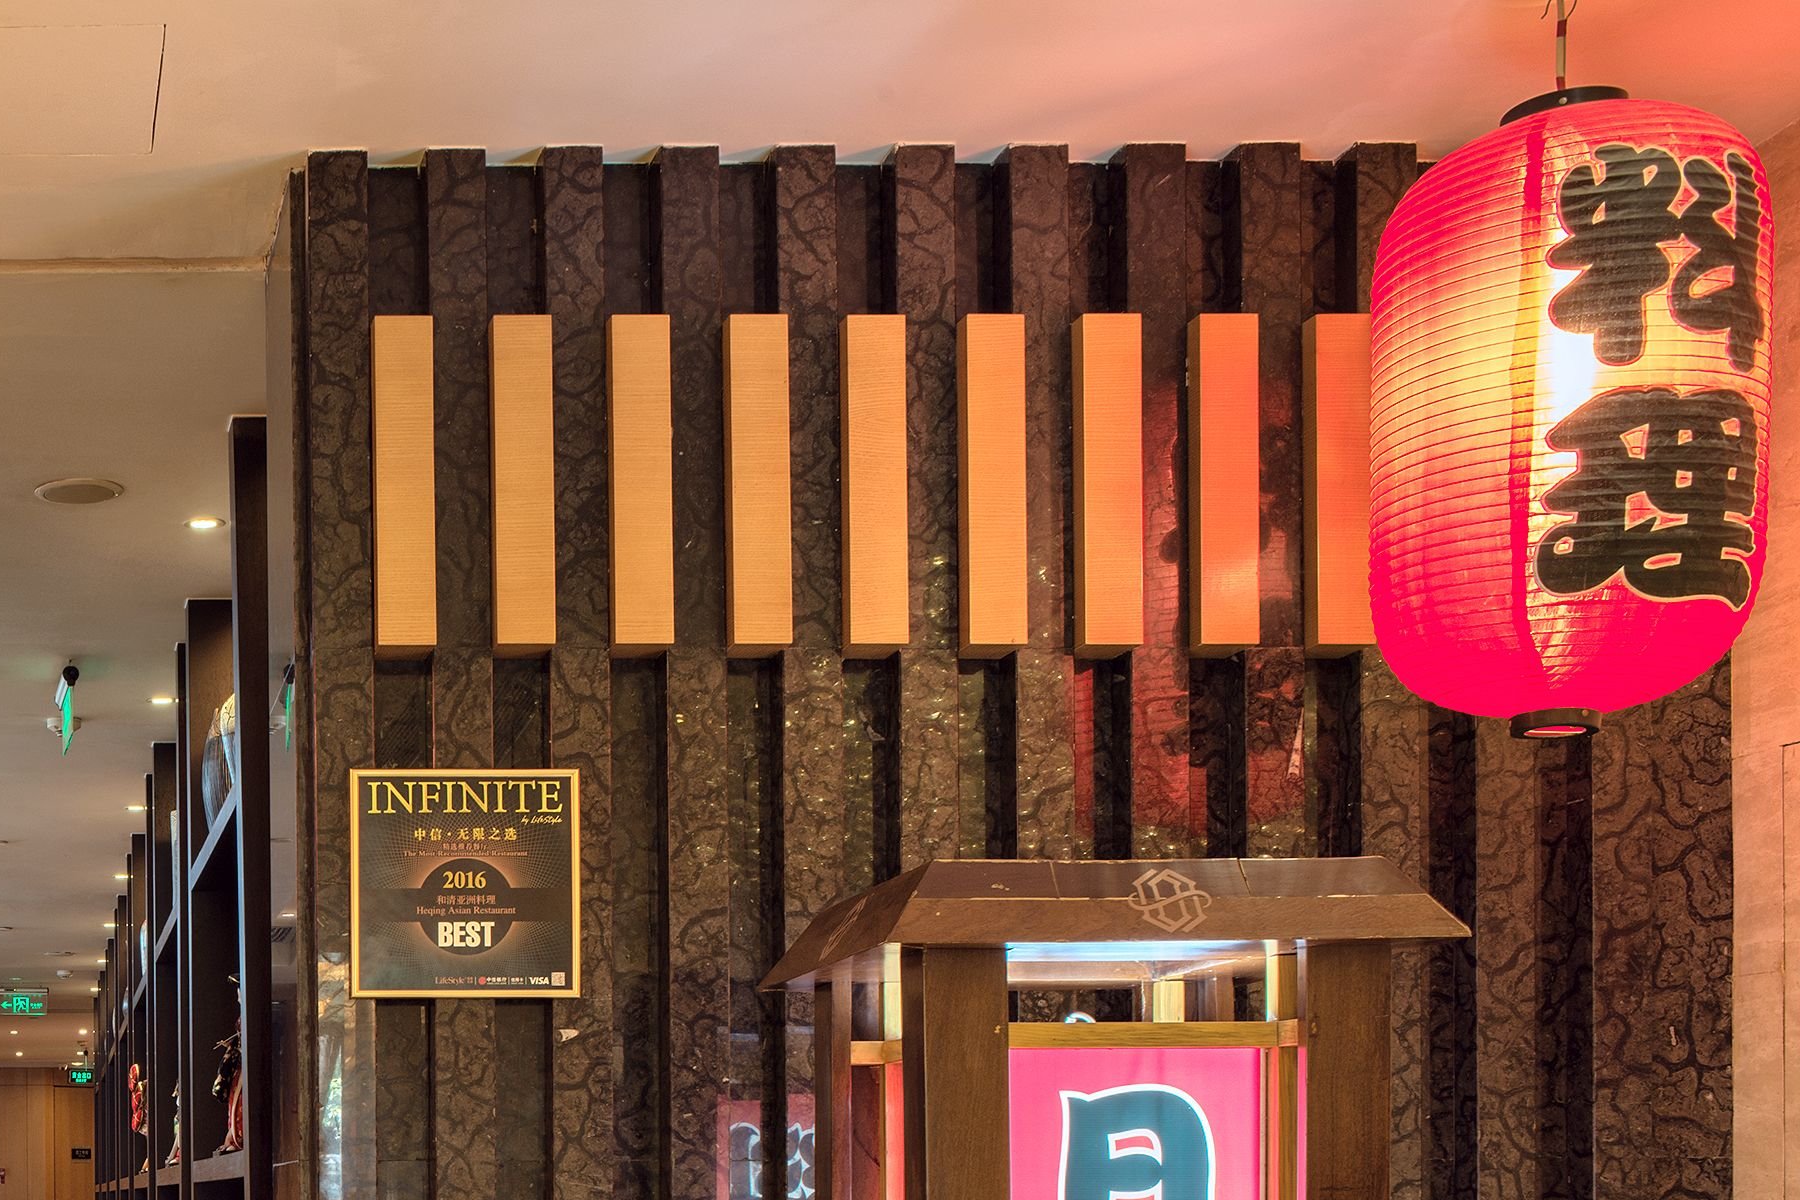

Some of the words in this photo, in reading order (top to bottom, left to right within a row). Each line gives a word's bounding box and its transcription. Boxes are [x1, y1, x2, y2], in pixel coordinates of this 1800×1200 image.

[1536, 143, 1764, 611] 料理
[367, 780, 563, 814] INFINITE
[520, 815, 530, 826] by
[530, 815, 563, 825] LifeStyle
[442, 871, 487, 889] 2016
[436, 894, 496, 905] 和清亚洲料理
[416, 906, 446, 917] Heqing
[448, 906, 471, 914] Asian
[473, 906, 517, 914] Restaurant
[437, 921, 495, 948] BEST
[529, 976, 550, 985] VISA
